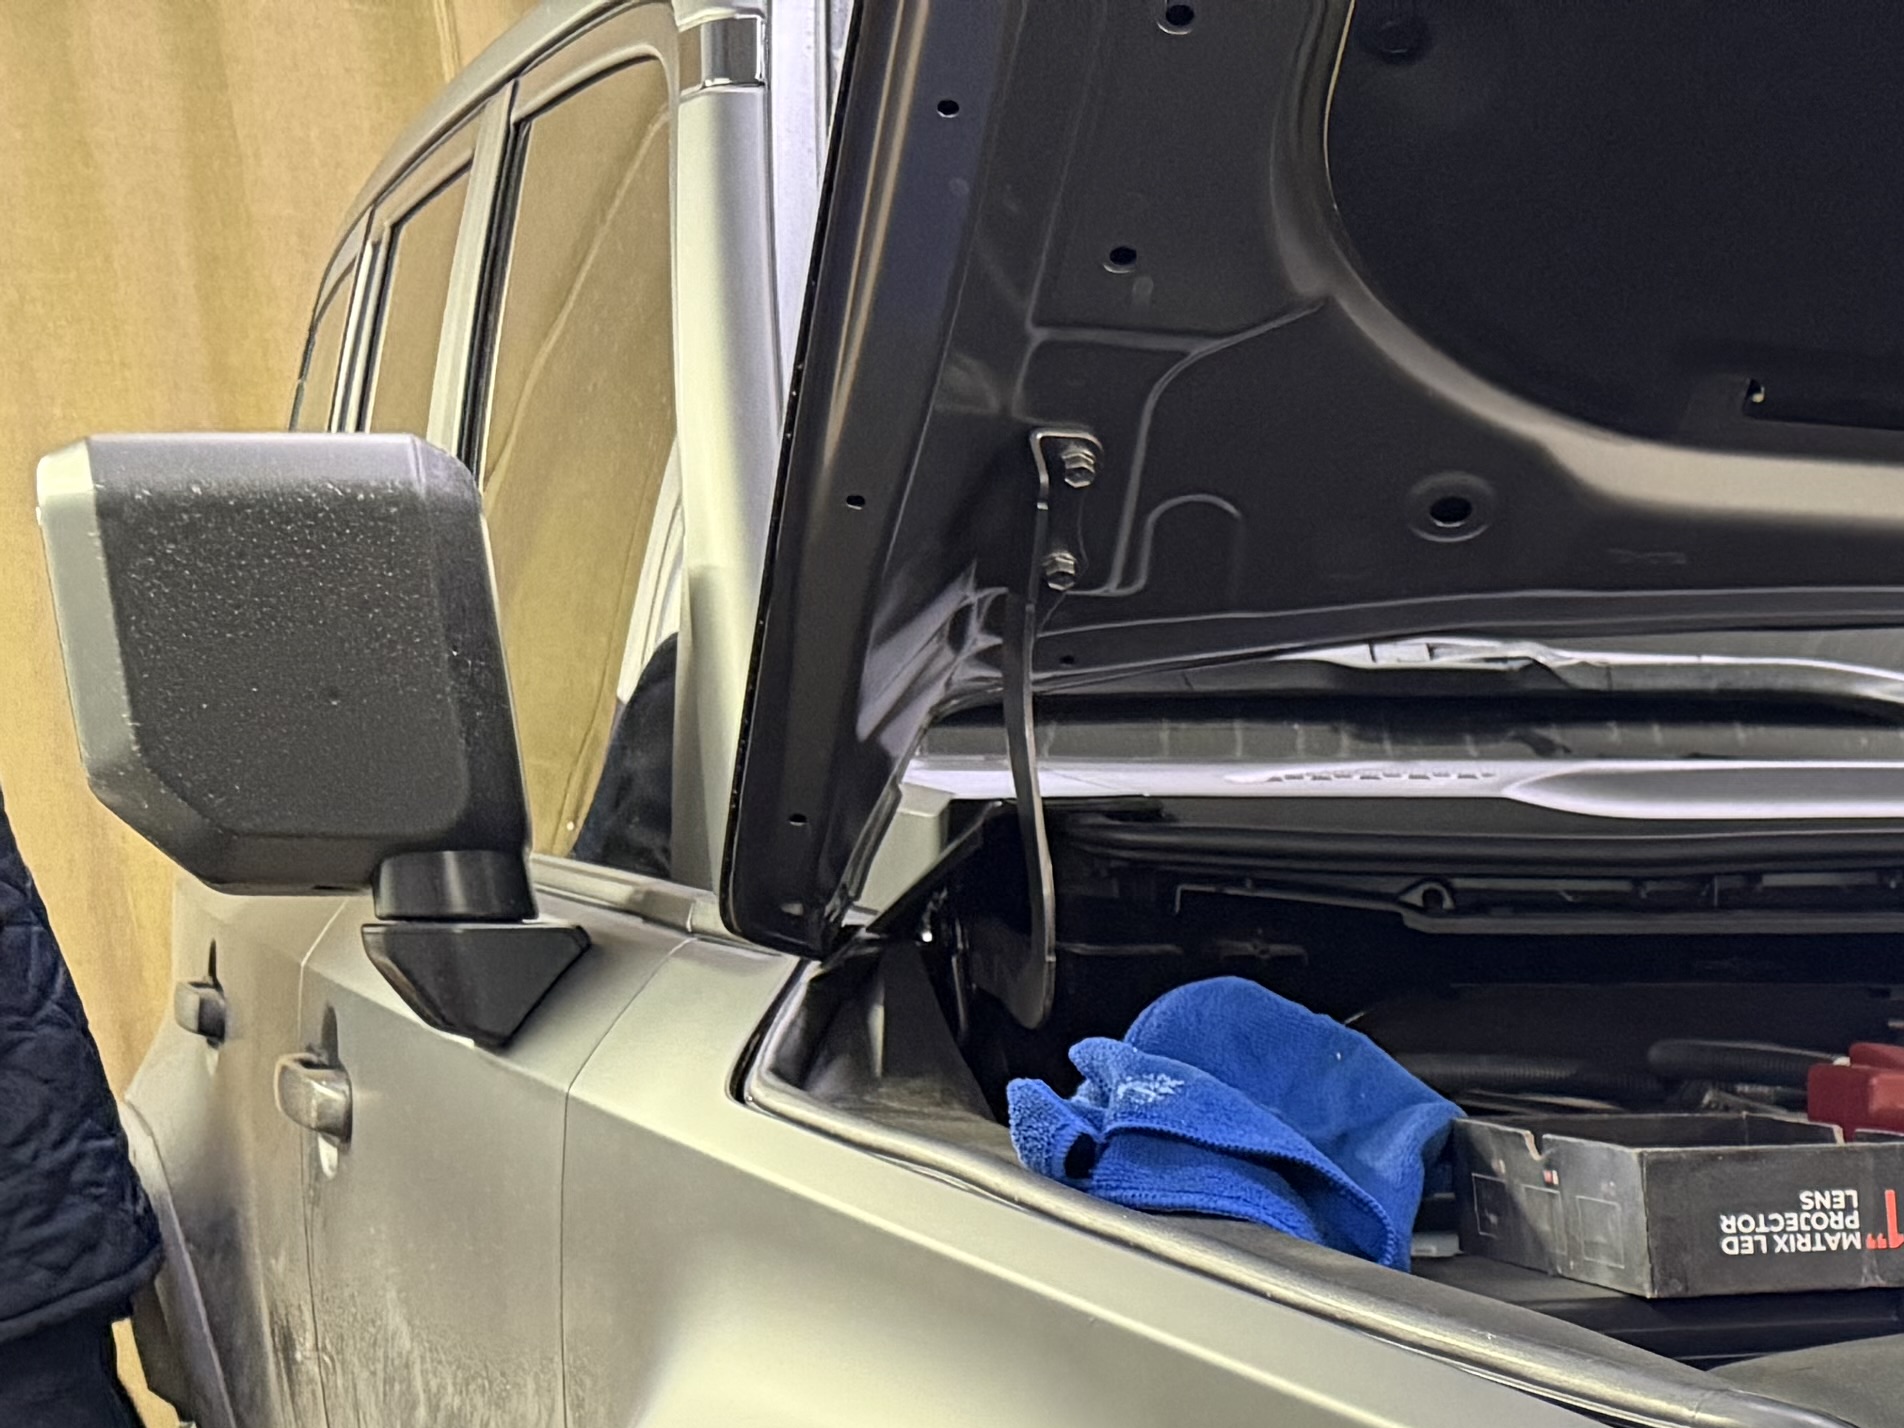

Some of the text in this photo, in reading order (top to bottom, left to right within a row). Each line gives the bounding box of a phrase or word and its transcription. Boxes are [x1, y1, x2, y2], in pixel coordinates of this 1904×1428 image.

[1799, 1188, 1859, 1211] LENS
[1719, 1210, 1861, 1234] PROJECTOR
[1720, 1231, 1862, 1256] MATRIX LED
